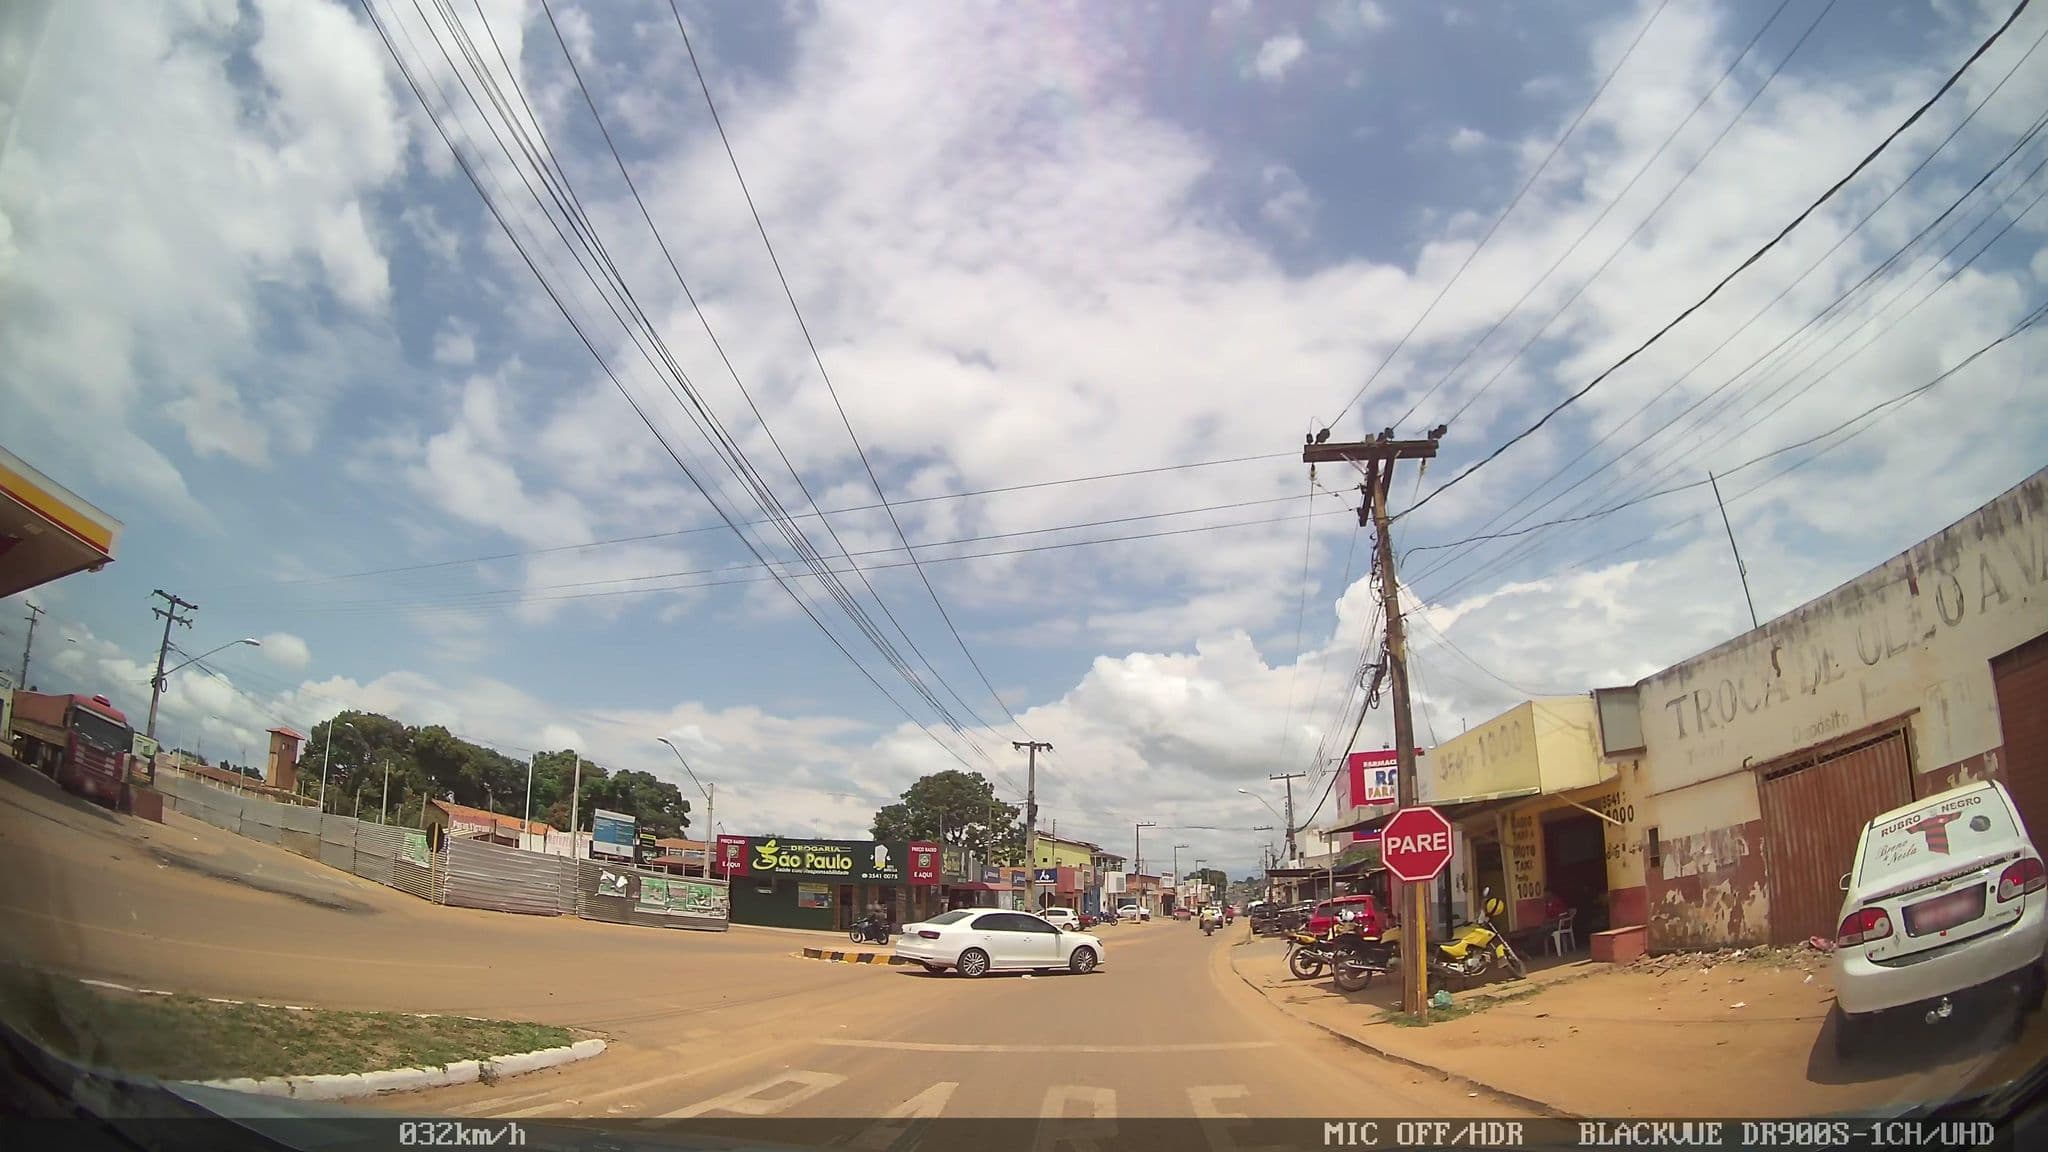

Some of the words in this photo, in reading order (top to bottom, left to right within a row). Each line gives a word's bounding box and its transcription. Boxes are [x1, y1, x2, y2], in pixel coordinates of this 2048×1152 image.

[1666, 672, 1790, 739] TROCA
[1880, 814, 1921, 838] RUBRO
[1941, 796, 1982, 813] NEGRO
[1387, 832, 1447, 855] PARE
[752, 846, 801, 870] São
[805, 852, 853, 870] Paulo
[918, 871, 933, 879] AQUI
